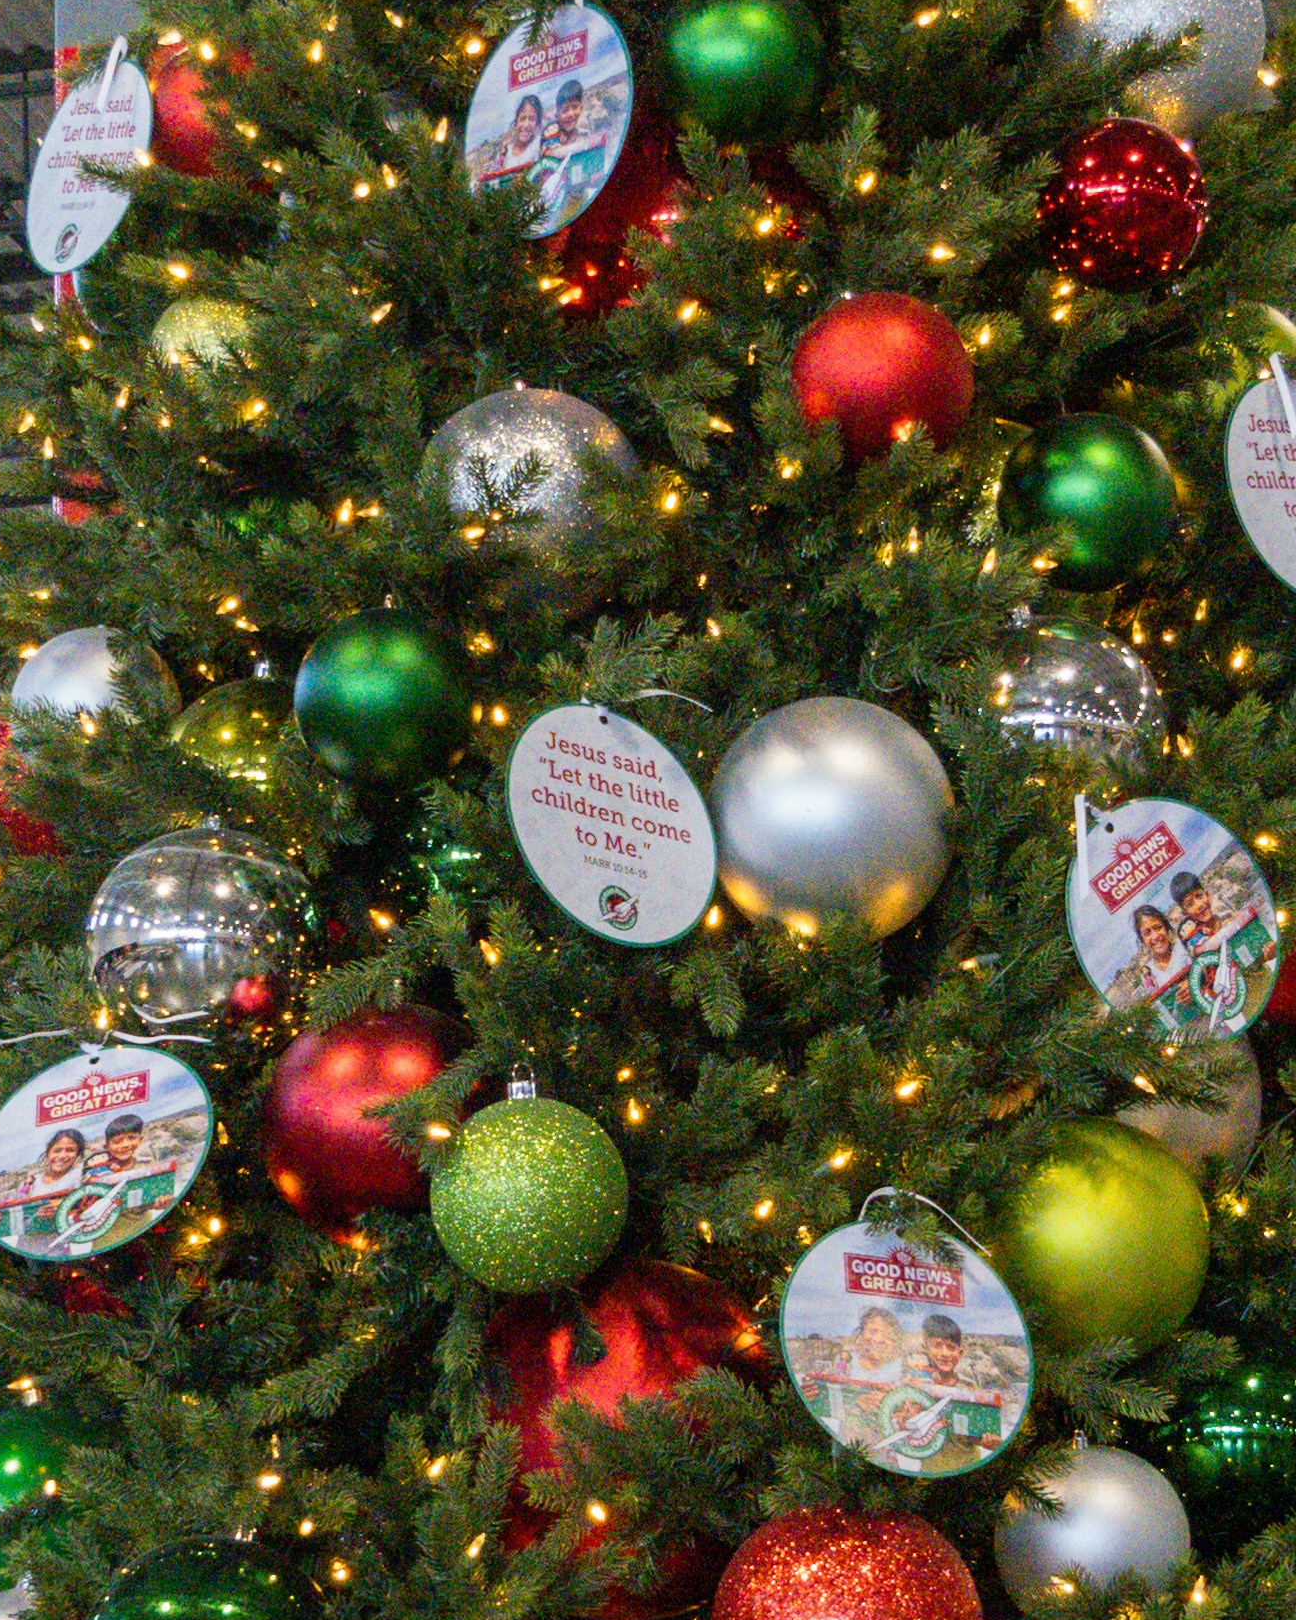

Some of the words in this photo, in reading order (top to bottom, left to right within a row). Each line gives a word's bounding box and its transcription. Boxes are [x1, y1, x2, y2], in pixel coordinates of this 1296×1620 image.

[513, 52, 546, 71] GOOD
[548, 37, 583, 60] NEWS.
[518, 61, 554, 82] GREAT
[557, 53, 578, 70] JOY.
[70, 99, 103, 115] Jesu
[86, 126, 105, 140] the
[108, 124, 136, 139] little
[63, 179, 74, 193] to
[1246, 442, 1281, 461] "Let
[546, 732, 606, 765] Jesus
[613, 753, 663, 782] said,
[539, 756, 582, 786] "Let
[588, 773, 623, 797] the
[629, 783, 680, 812] little
[531, 786, 626, 826] children
[632, 817, 692, 844] come
[575, 826, 597, 847] to
[604, 832, 651, 860] Me."
[583, 855, 611, 868] MARK
[1097, 859, 1133, 894] GOOD
[1131, 831, 1169, 865] NEWS.
[1111, 866, 1150, 900] GREAT
[1150, 850, 1172, 873] JOY.
[43, 1088, 91, 1109] GOOD
[93, 1077, 143, 1097] NEWS.
[50, 1098, 101, 1119] GREAT
[105, 1090, 136, 1108] JOY.
[851, 1259, 902, 1277] GOOD
[904, 1266, 957, 1286] NEWS.
[861, 1275, 915, 1294] GREAT
[918, 1282, 950, 1299] JOY.
